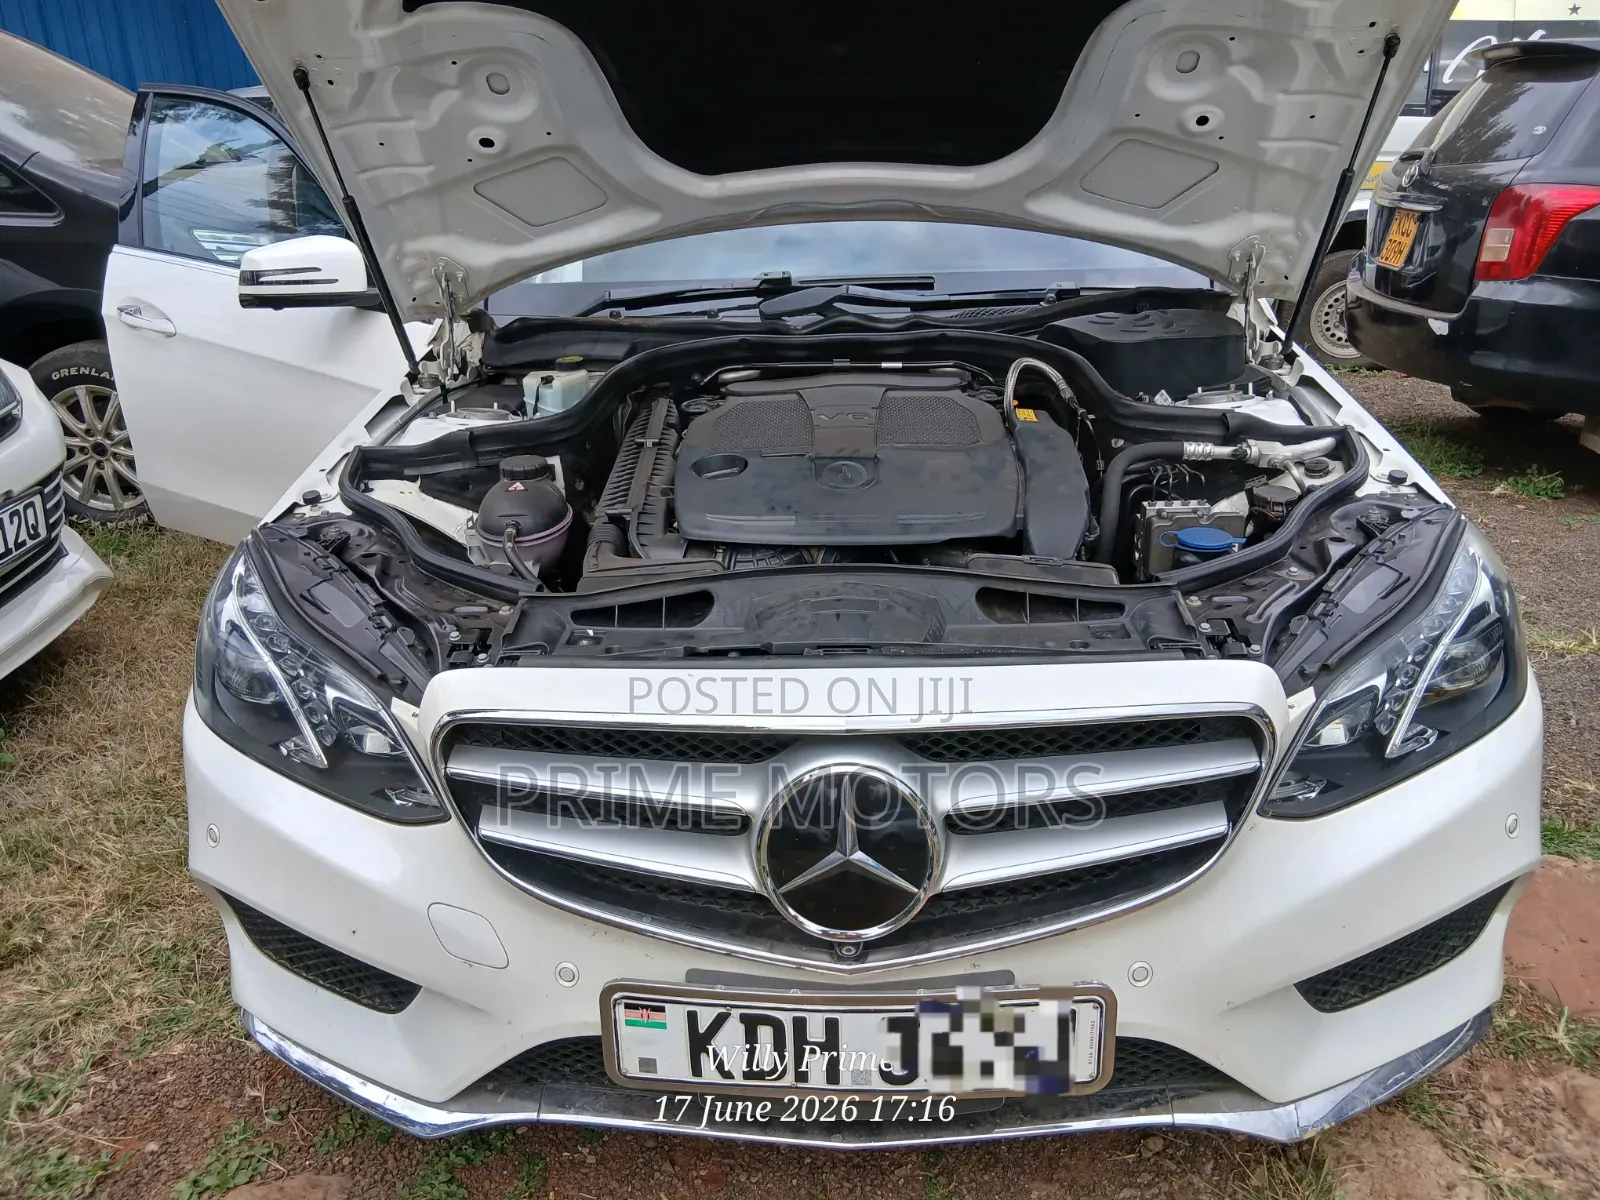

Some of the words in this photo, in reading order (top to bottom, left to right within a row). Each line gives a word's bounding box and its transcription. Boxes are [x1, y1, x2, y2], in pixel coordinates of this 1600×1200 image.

[52, 366, 115, 381] GRENLA
[0, 500, 41, 559] 12Q
[686, 1009, 840, 1085] KDH
